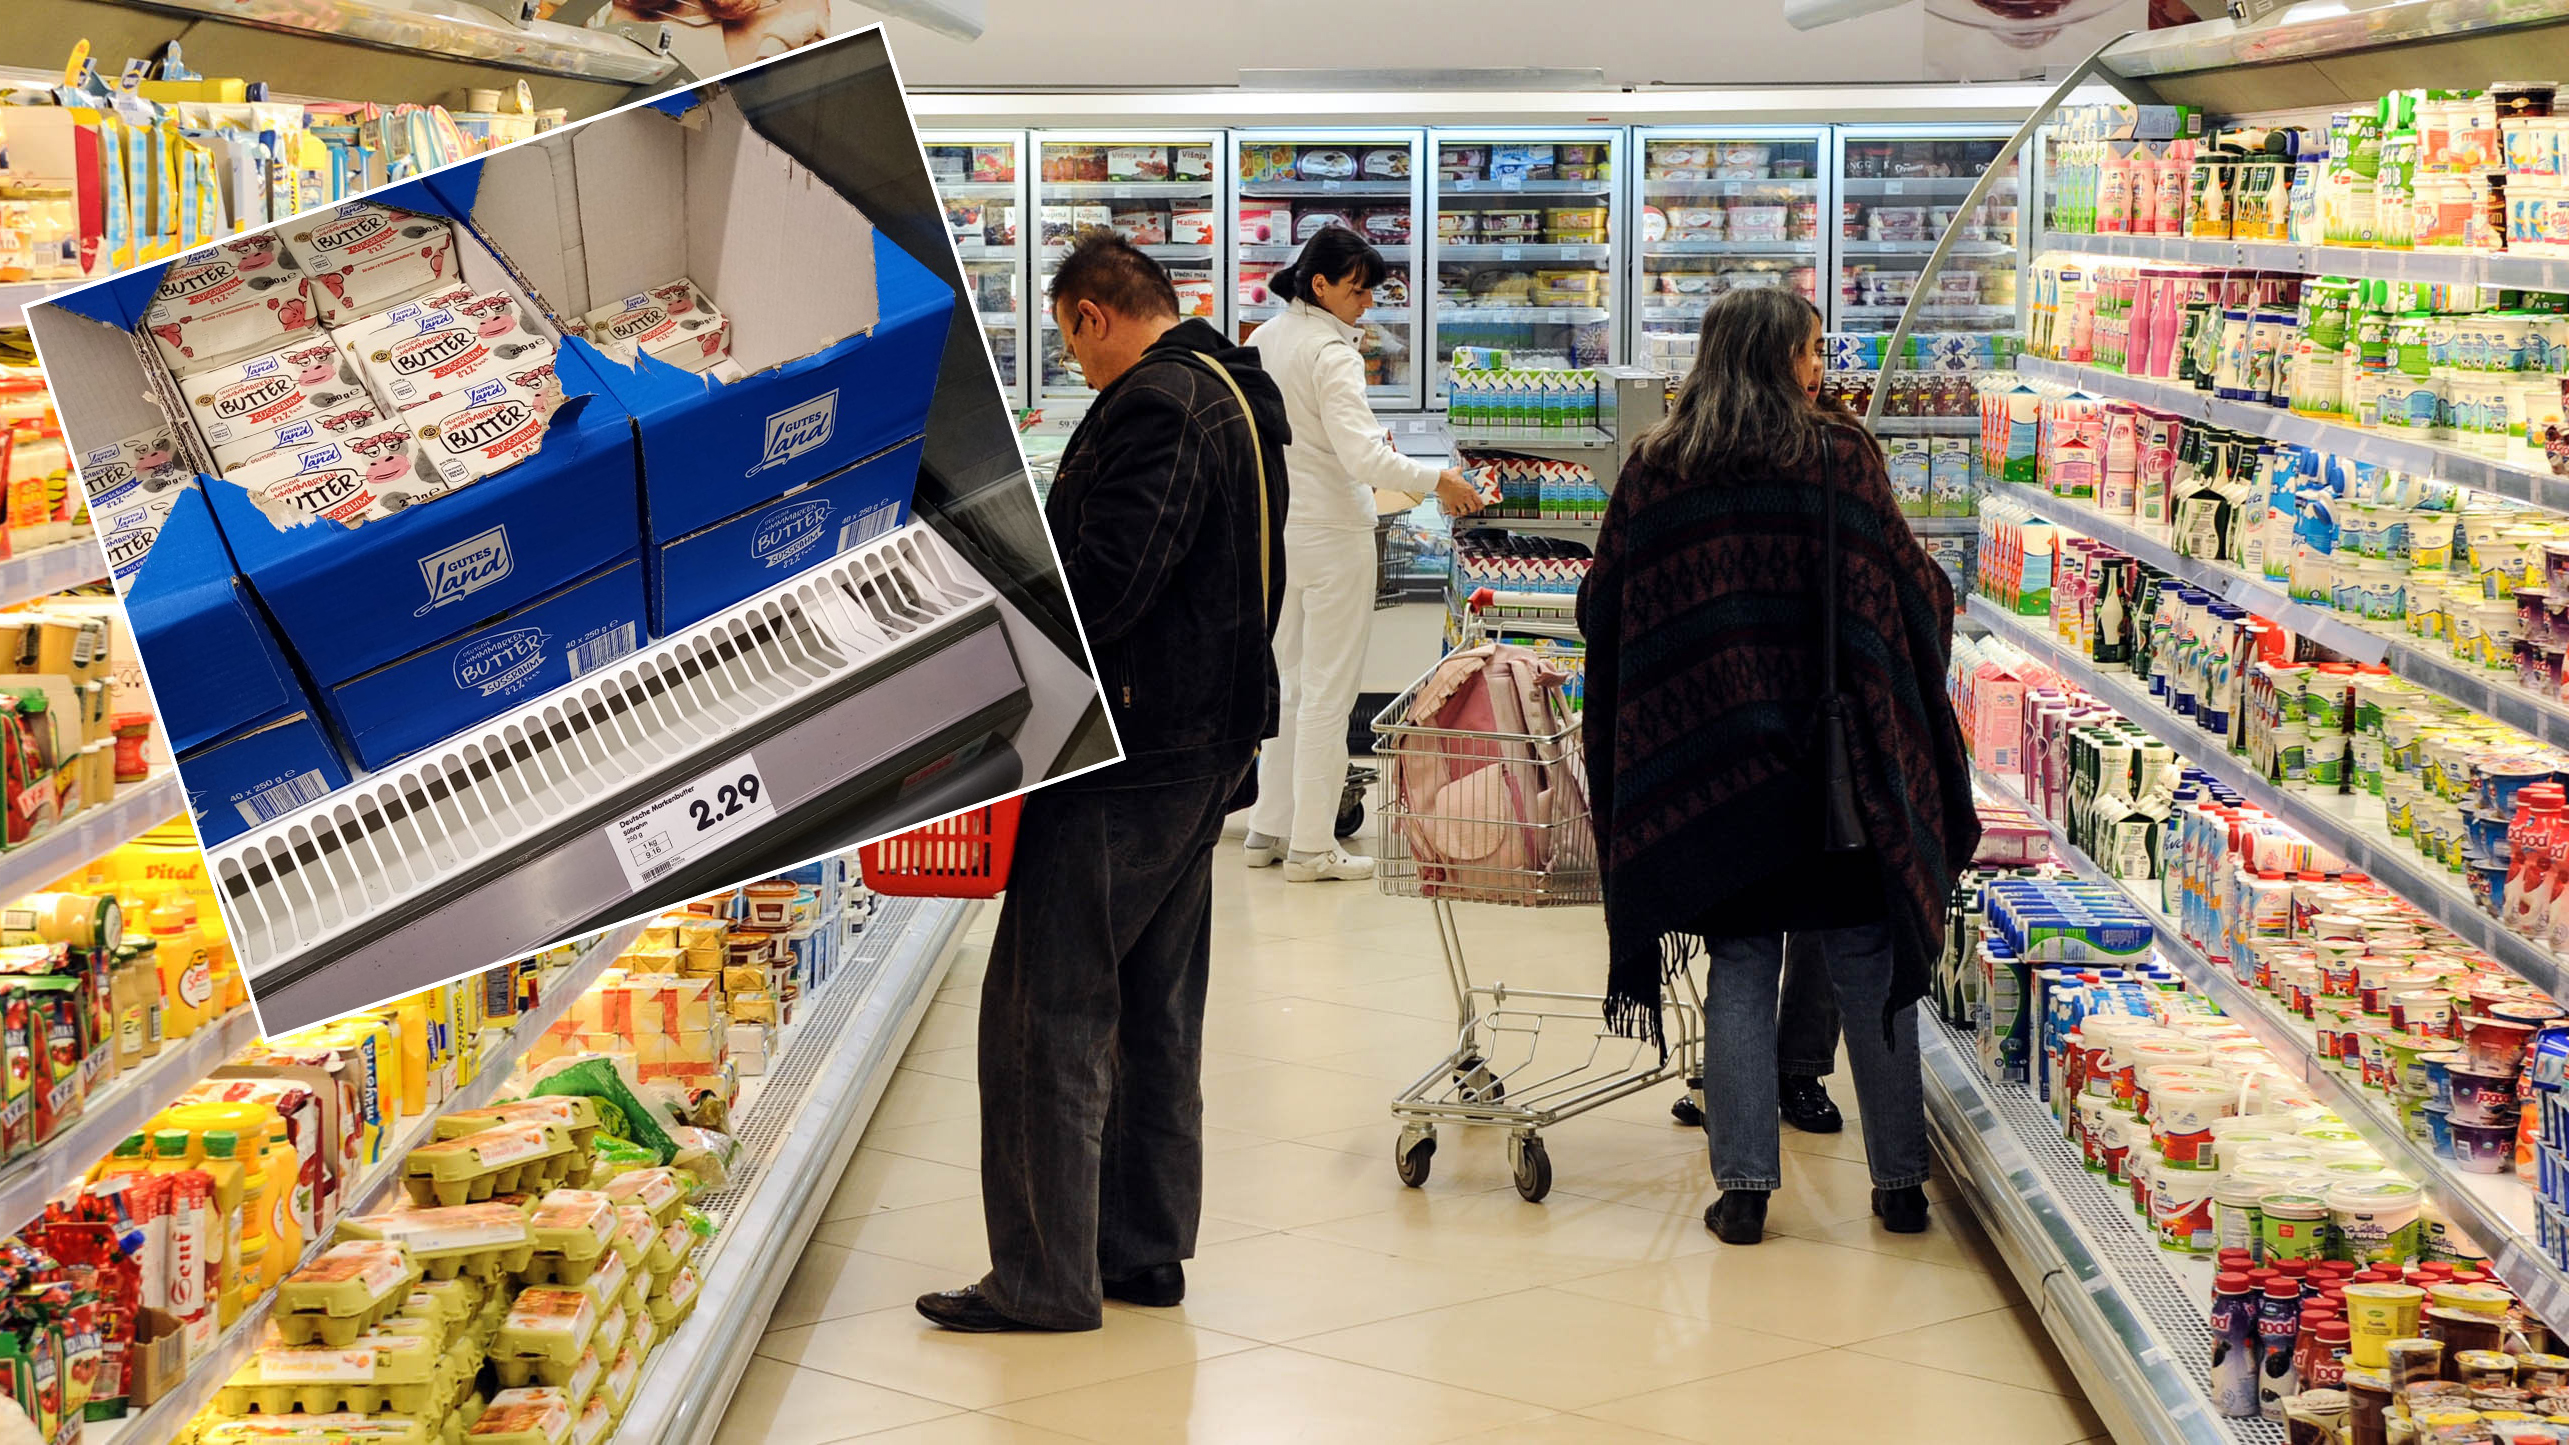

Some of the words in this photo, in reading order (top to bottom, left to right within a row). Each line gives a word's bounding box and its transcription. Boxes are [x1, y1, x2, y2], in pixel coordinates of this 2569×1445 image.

[1181, 150, 1207, 161] Višnja
[1176, 218, 1203, 227] Malina
[317, 217, 383, 249] BUTTER
[160, 265, 229, 298] BUTTER
[2322, 298, 2339, 309] AB
[390, 309, 419, 324] Land
[420, 315, 450, 333] Land
[613, 310, 663, 337] BUTTER
[398, 332, 470, 371] BUTTER
[510, 344, 529, 357] 250
[246, 363, 276, 380] Land
[456, 365, 477, 379] 82%
[220, 379, 290, 415] BUTTER
[470, 385, 502, 406] Land
[271, 412, 290, 424] 82%
[448, 406, 524, 449] BUTTER
[785, 411, 823, 433] GUTES
[278, 427, 310, 447] Land
[758, 412, 829, 465] Land
[303, 451, 337, 471] Land
[115, 512, 144, 528] Land
[841, 516, 852, 524] 40
[858, 507, 872, 517] 250
[757, 507, 826, 553] BUTTER
[447, 547, 492, 573] GUTES
[783, 554, 801, 569] 82%
[424, 547, 508, 606] Land
[565, 640, 576, 650] 40
[584, 629, 600, 641] 250
[461, 634, 541, 684] BUTTER
[504, 680, 525, 696] 82%
[230, 792, 243, 802] 40
[245, 789, 253, 797] x
[253, 779, 273, 793] 250
[275, 776, 283, 785] g
[619, 808, 651, 830] Deutsche
[651, 785, 695, 813] Markenbutter
[688, 773, 760, 832] 2.29
[626, 834, 639, 844] 250
[648, 839, 658, 848] kg
[645, 846, 662, 860] 9.16
[145, 863, 200, 881] Vital
